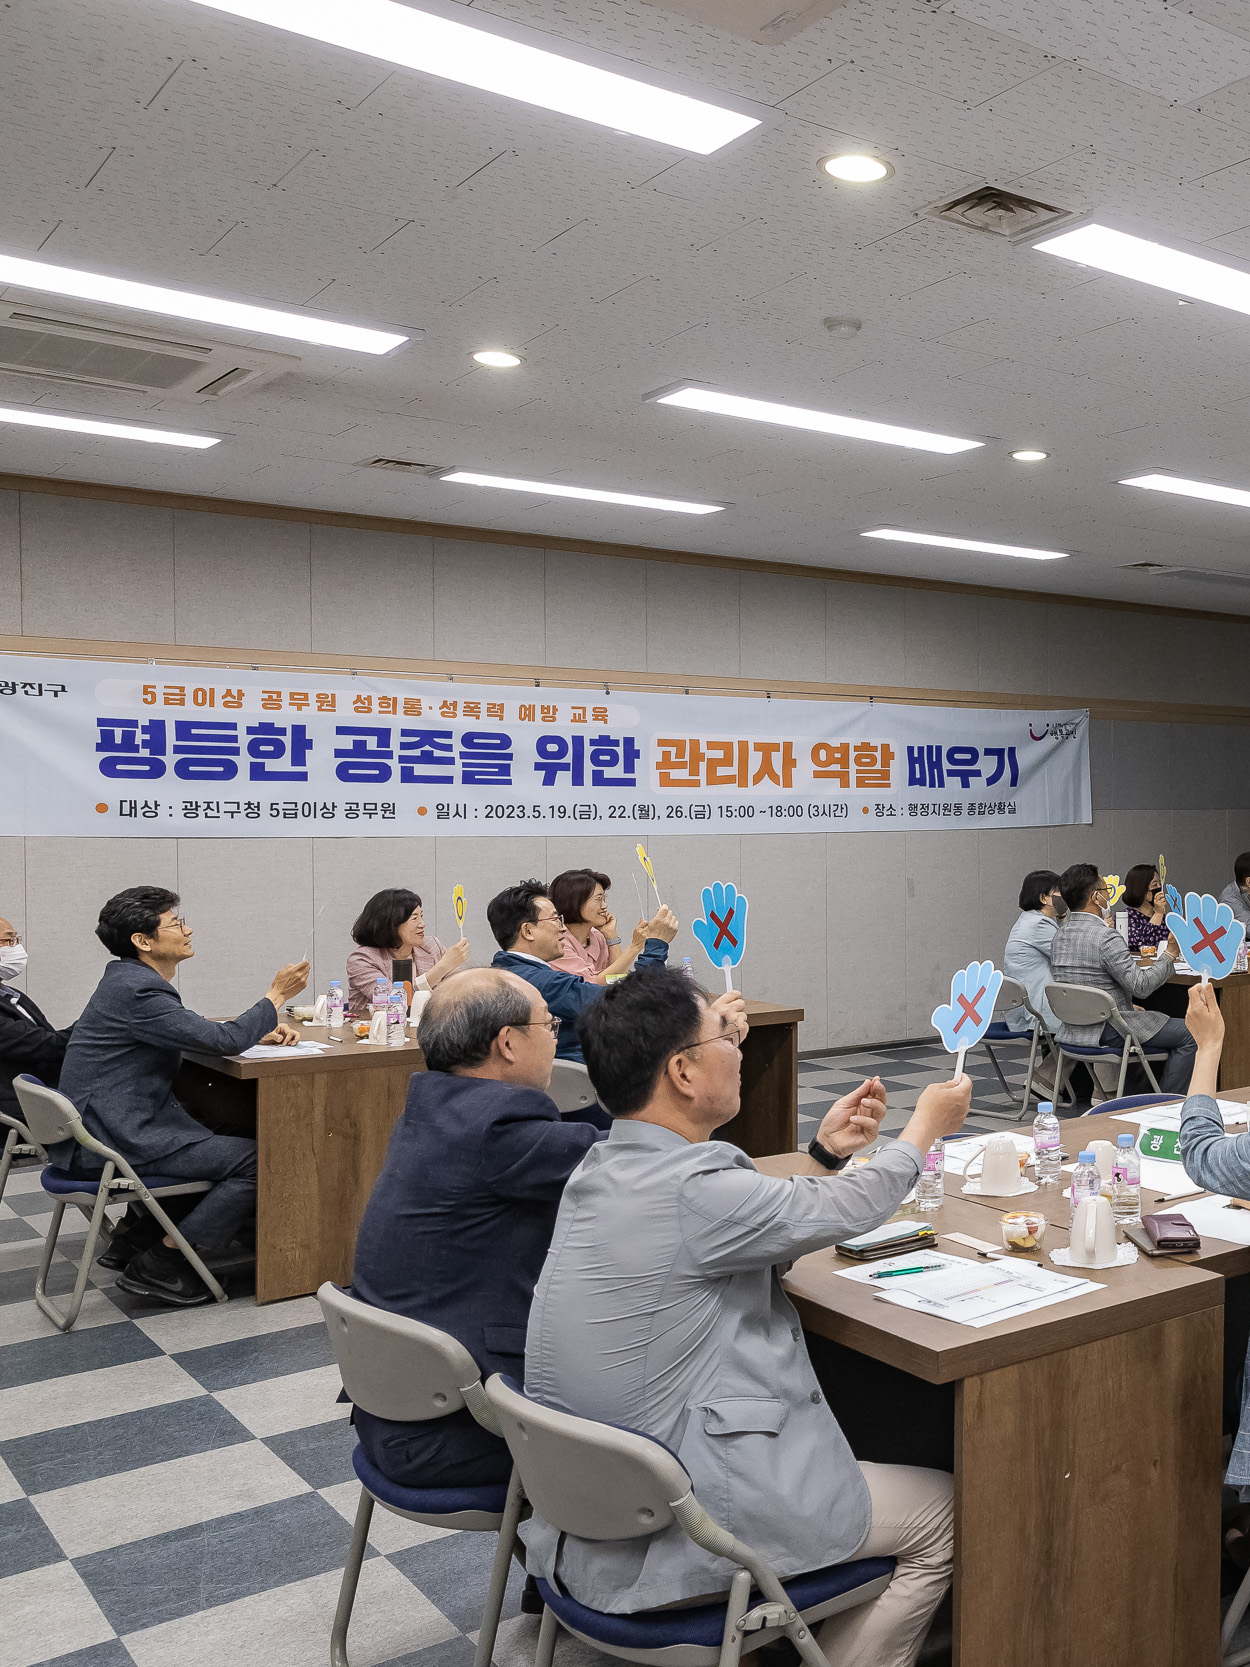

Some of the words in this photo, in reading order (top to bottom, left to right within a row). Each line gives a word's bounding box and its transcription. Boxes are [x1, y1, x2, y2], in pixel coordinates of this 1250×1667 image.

[0, 680, 68, 698] 광진구
[142, 684, 245, 709] 5급이상
[261, 690, 337, 714] 공무원
[352, 694, 505, 721] 성희롱·성폭력
[518, 703, 559, 724] 예방
[570, 706, 609, 725] 교육
[96, 717, 313, 782] 평등한
[334, 726, 514, 786] 공존을
[534, 734, 640, 788] 위한
[656, 738, 797, 788] 관리자
[811, 741, 896, 788] 역할
[907, 744, 1020, 788] 배우기
[119, 800, 160, 819] 대상
[181, 801, 262, 820] 광진구청
[269, 801, 338, 820] 5급이상
[344, 802, 396, 820] 공무원
[436, 803, 468, 820] 일시
[608, 804, 660, 821] 22.(월),
[666, 804, 712, 820] 26.(금)
[718, 805, 754, 818] 15:00
[759, 804, 804, 818] ~18:00
[808, 803, 848, 818] (3시간)
[874, 803, 897, 818] 장소
[908, 802, 964, 818] 행정지원동
[967, 801, 1017, 816] 종합상황실
